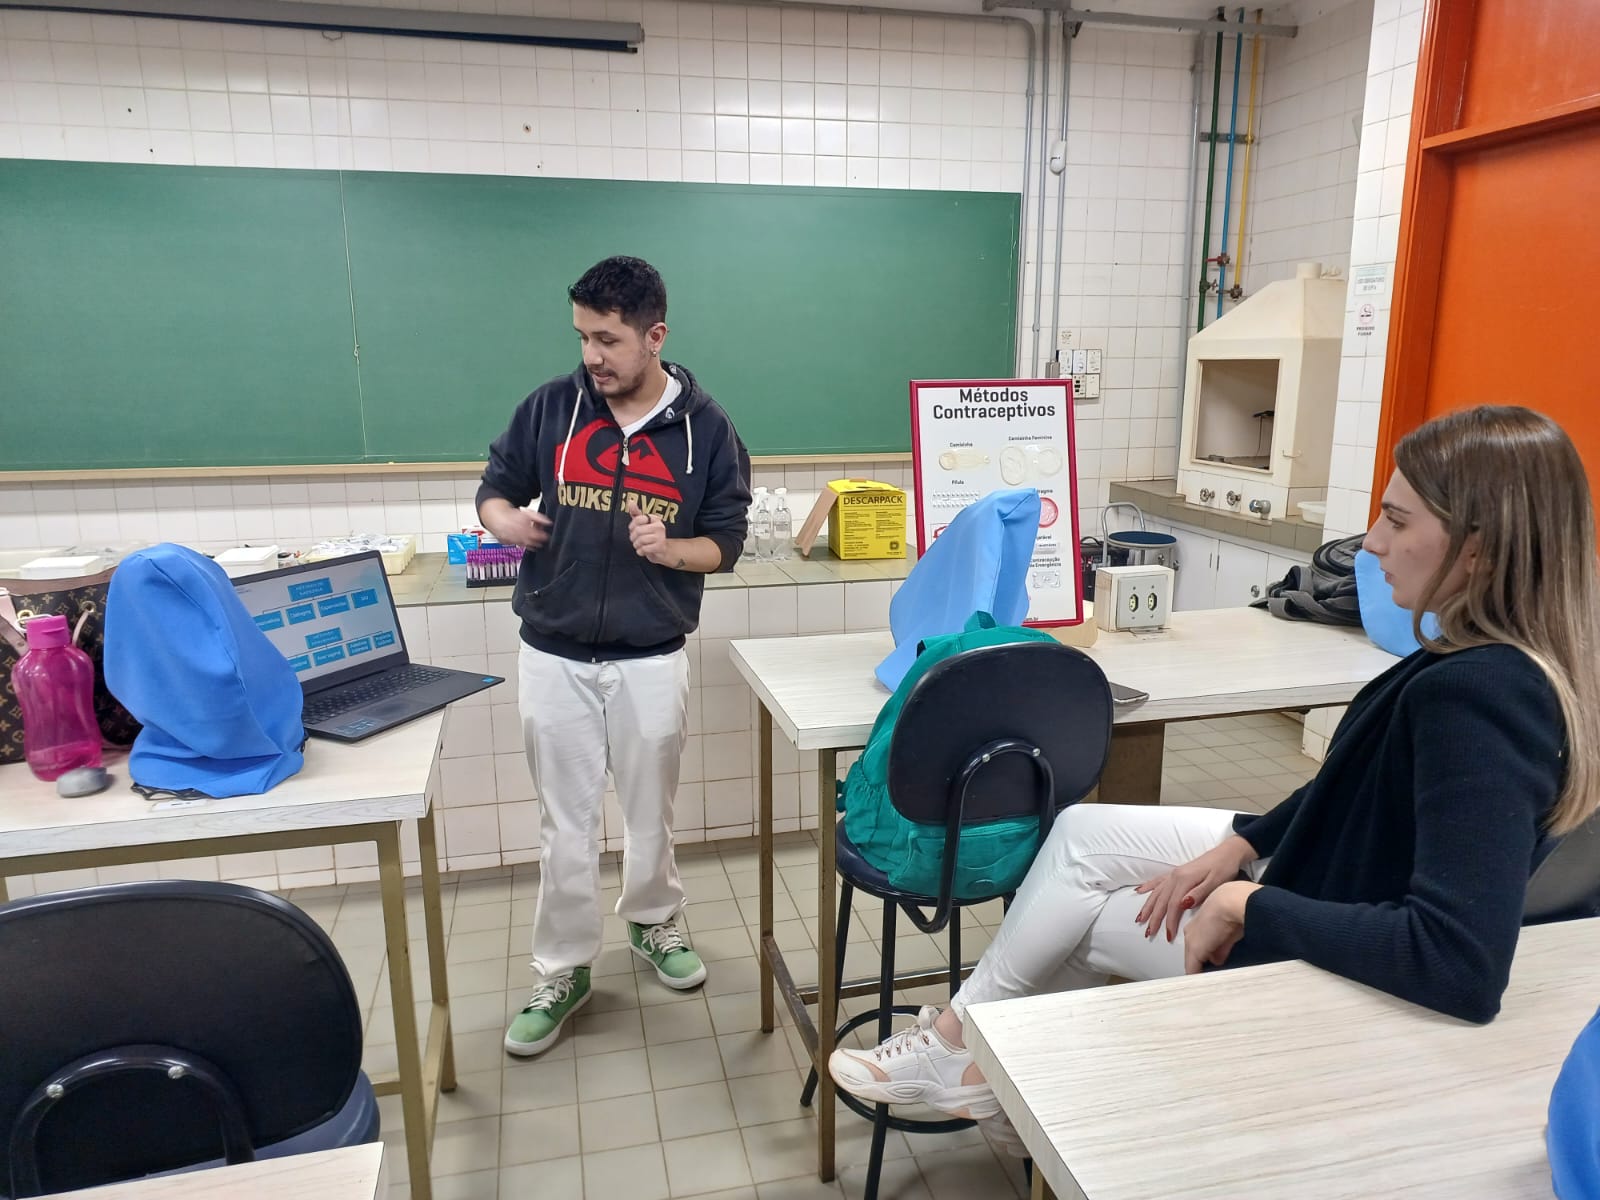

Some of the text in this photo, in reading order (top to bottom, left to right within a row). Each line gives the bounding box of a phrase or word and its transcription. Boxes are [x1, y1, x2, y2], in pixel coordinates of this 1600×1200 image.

[959, 387, 1028, 403] Métodos
[933, 403, 1055, 421] Contraceptivos
[843, 495, 903, 505] DESCARPACK
